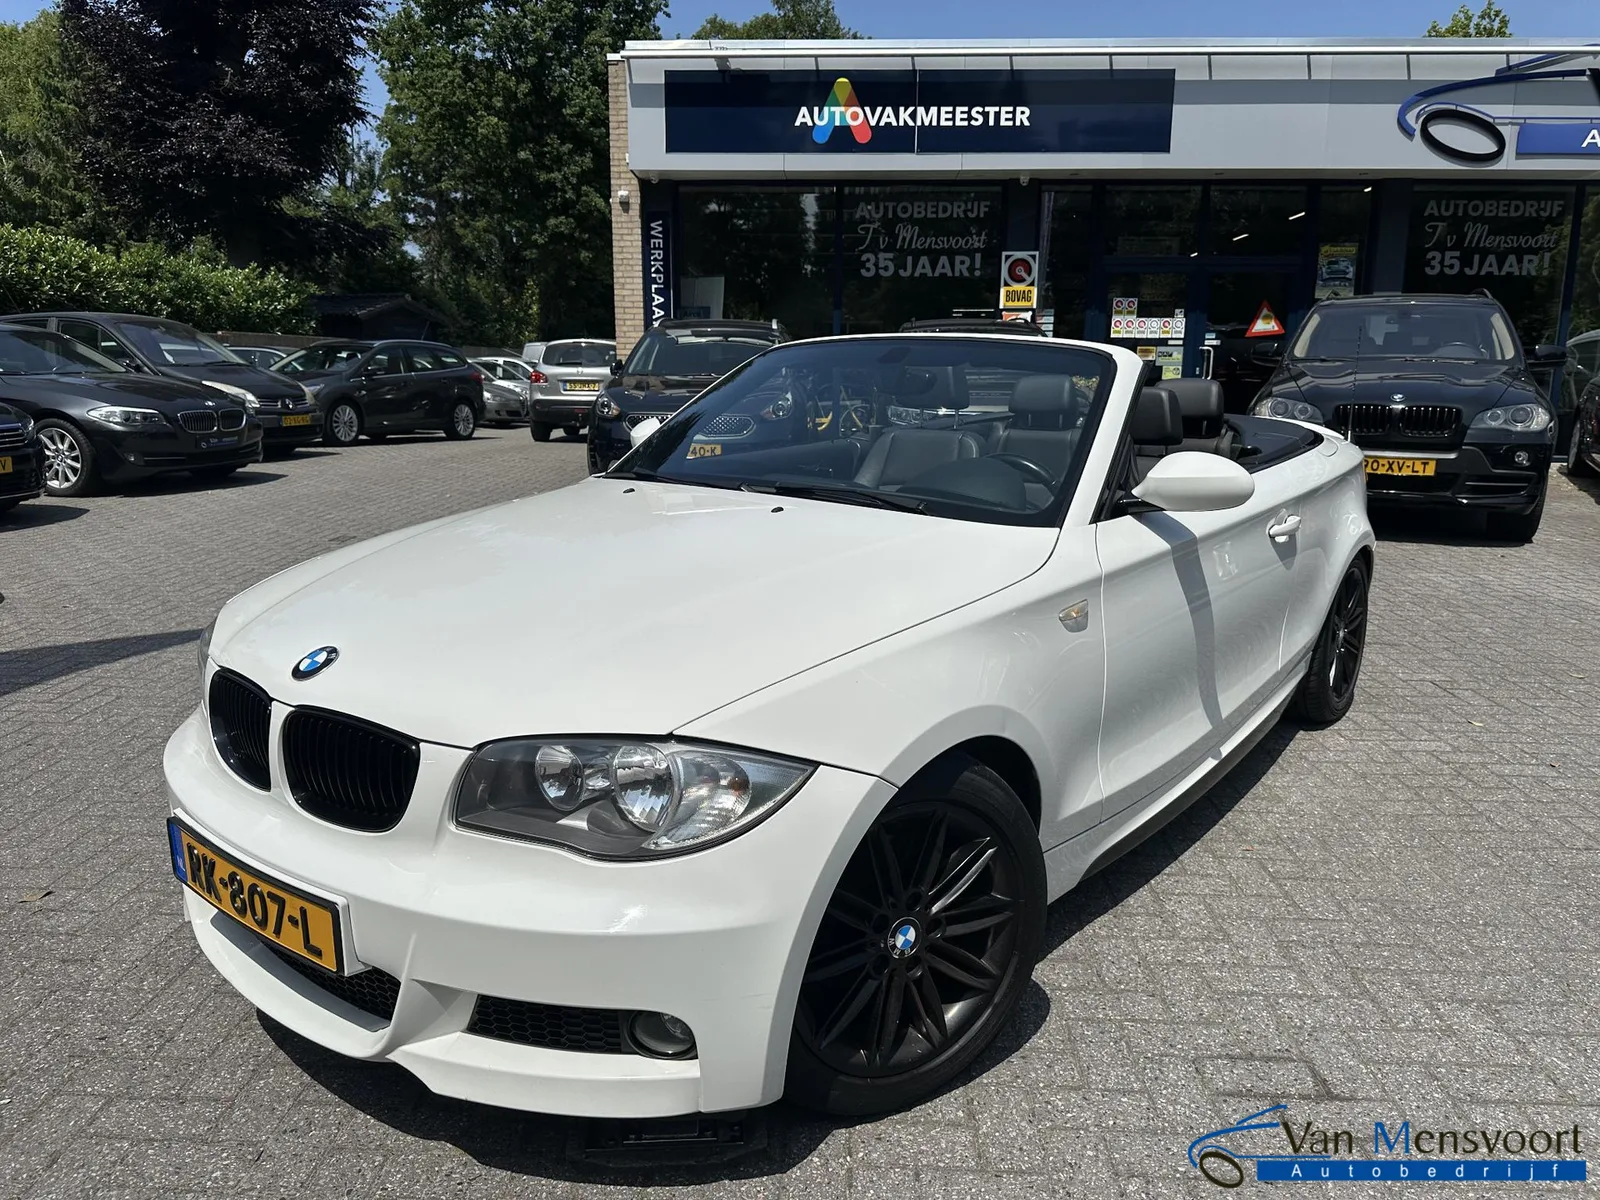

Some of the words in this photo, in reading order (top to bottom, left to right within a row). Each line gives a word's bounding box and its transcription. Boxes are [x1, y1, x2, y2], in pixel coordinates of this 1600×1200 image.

[794, 106, 1031, 126] AUTOVAKMEESTER
[855, 201, 991, 218] AUTOBEDRIJF
[1423, 200, 1564, 217] AUTOBEDRIJF
[895, 223, 987, 249] Mensvoort
[1464, 221, 1557, 248] Mensvoort
[860, 252, 895, 278] 35
[898, 253, 982, 277] JAAR!
[1424, 251, 1460, 275] 35
[1464, 251, 1550, 276] JAAR!
[1005, 289, 1032, 303] BOVAG
[187, 842, 323, 960] RK-807-L
